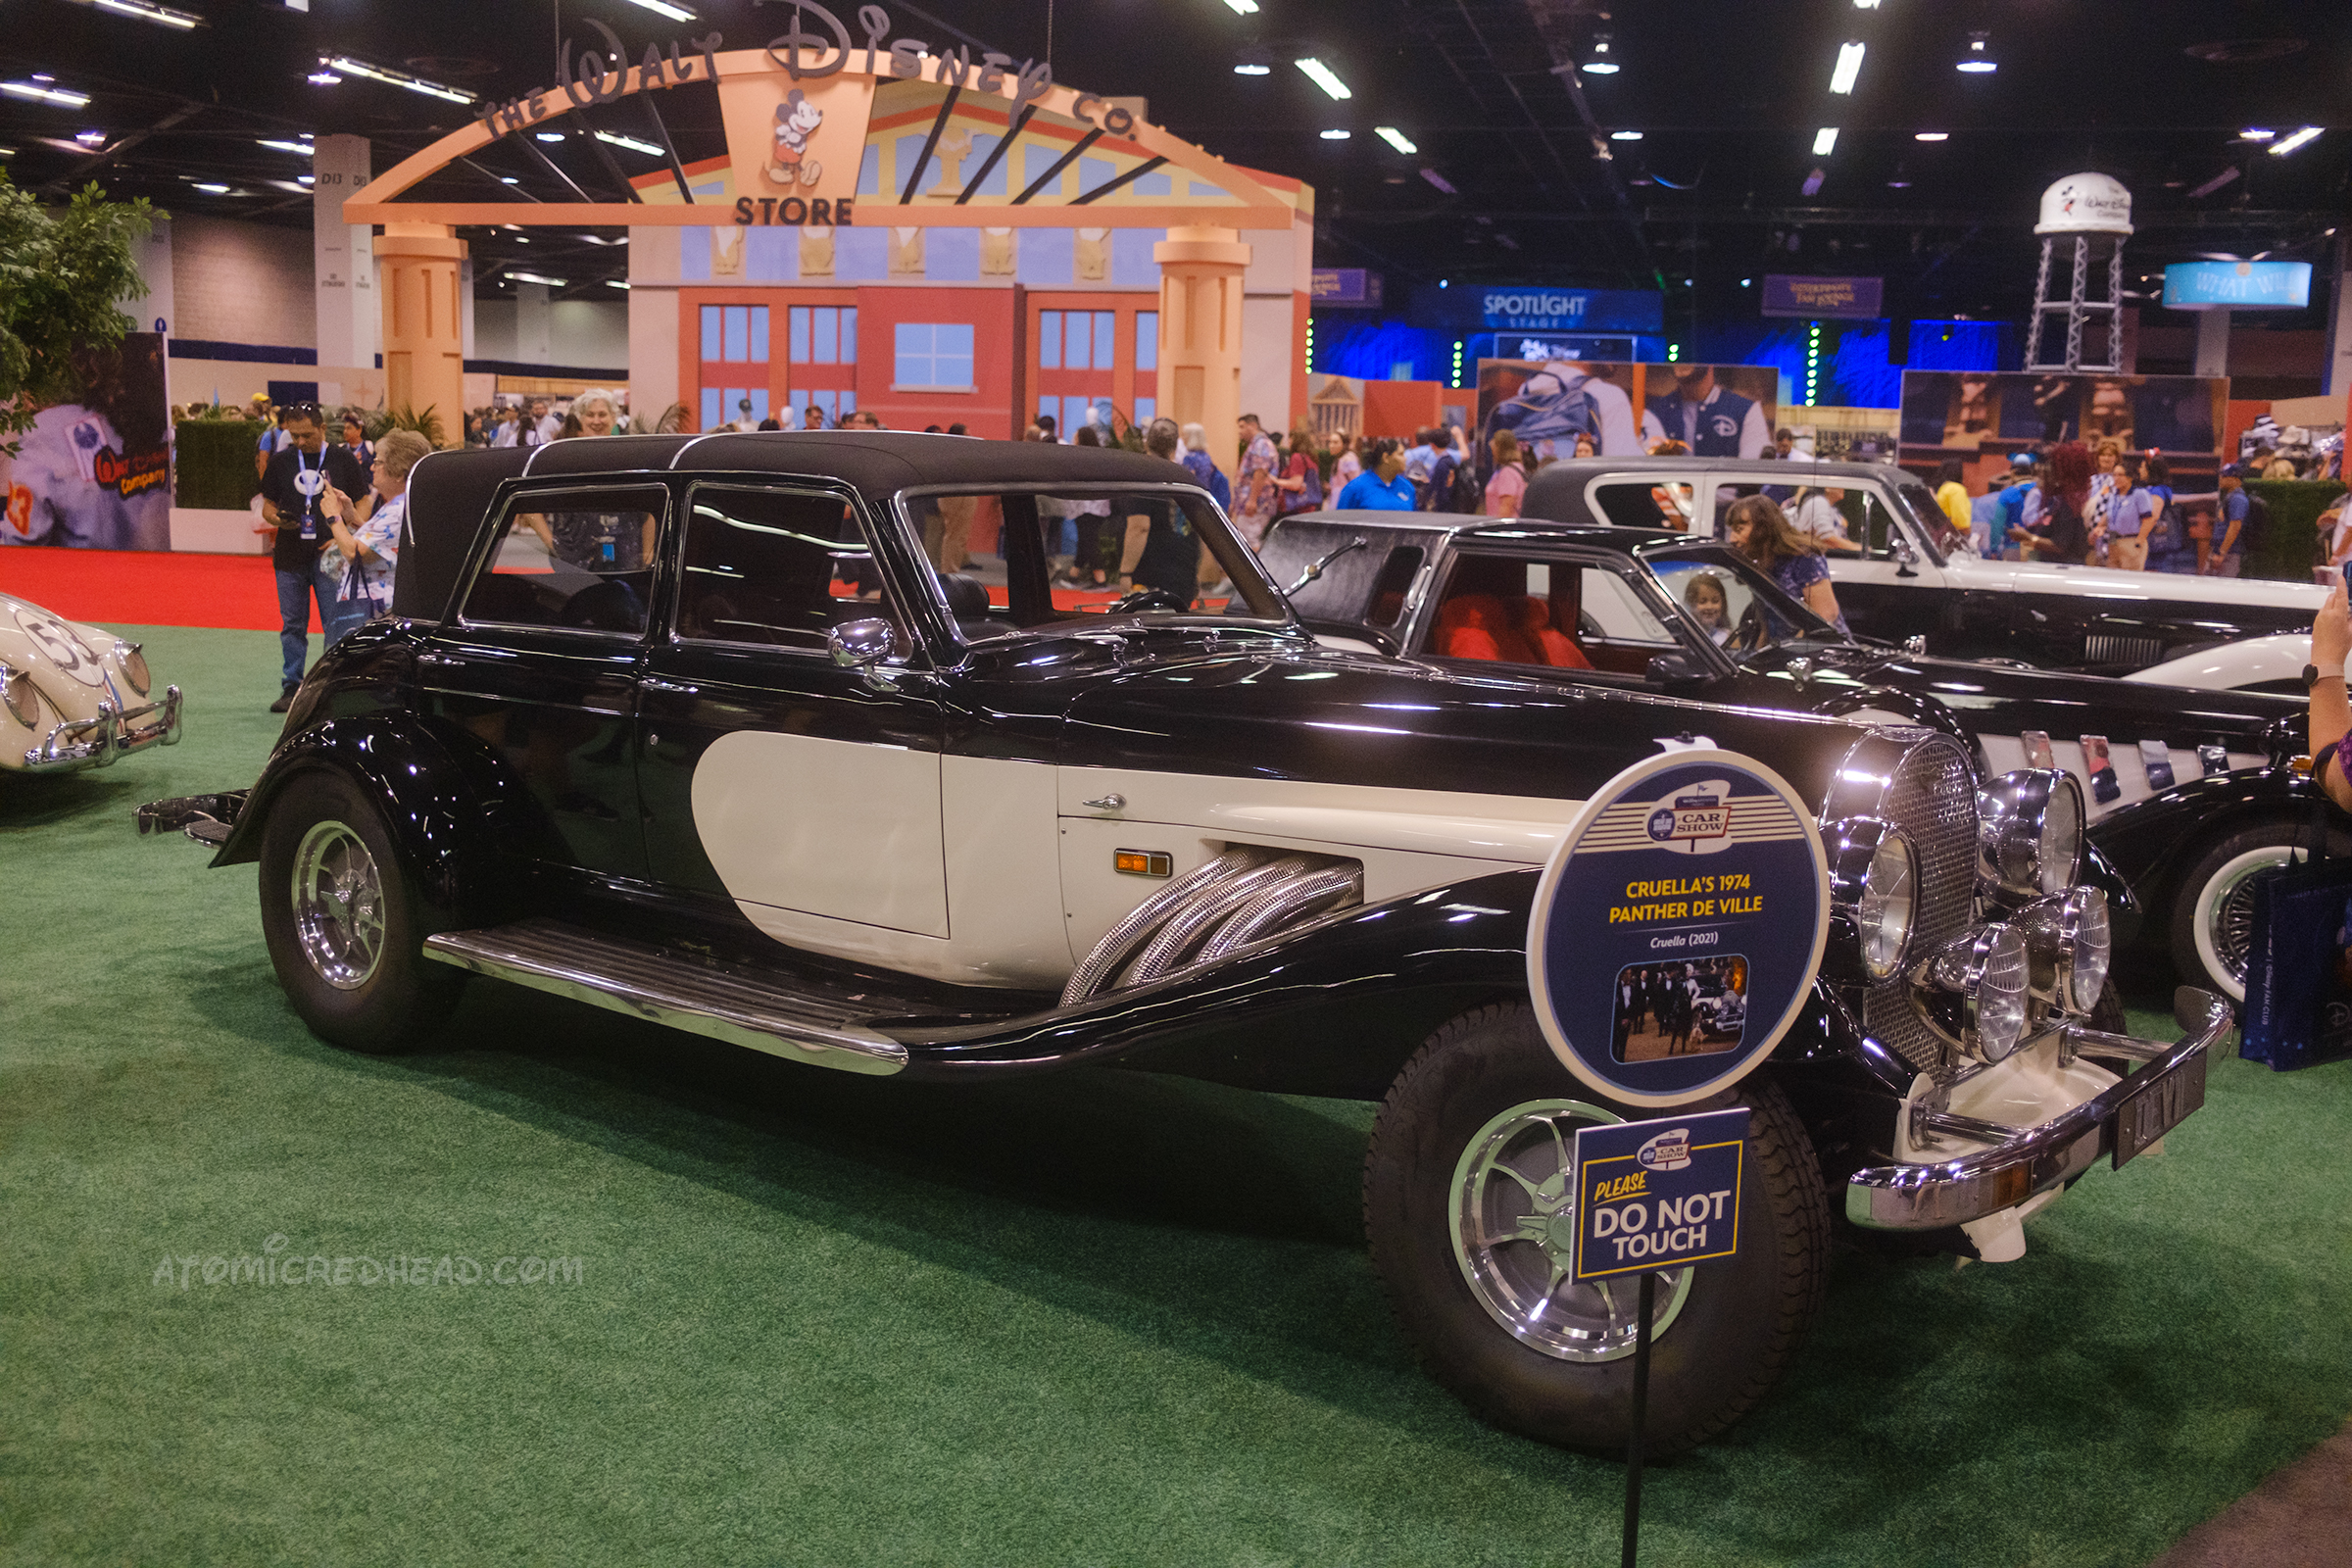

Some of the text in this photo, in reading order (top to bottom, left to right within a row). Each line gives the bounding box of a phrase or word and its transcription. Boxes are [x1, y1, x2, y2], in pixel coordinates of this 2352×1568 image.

[1072, 92, 1137, 142] CO.
[735, 197, 853, 225] STORE
[2196, 271, 2252, 298] WHAT
[1484, 294, 1587, 316] SPOTLIGHT
[26, 619, 101, 671] 53
[1677, 822, 1724, 832] SHOW
[1682, 813, 1721, 823] CAR
[1626, 873, 1751, 899] CRUELLA'S 1974
[1608, 895, 1763, 923] PANTHER DE VILLE
[1649, 931, 1719, 949] Cruella (2021)
[2261, 1006, 2271, 1025] CLUB
[1593, 1170, 1648, 1201] PLEASE
[1593, 1190, 1731, 1238] DO NOT
[1612, 1225, 1707, 1260] TOUCH
